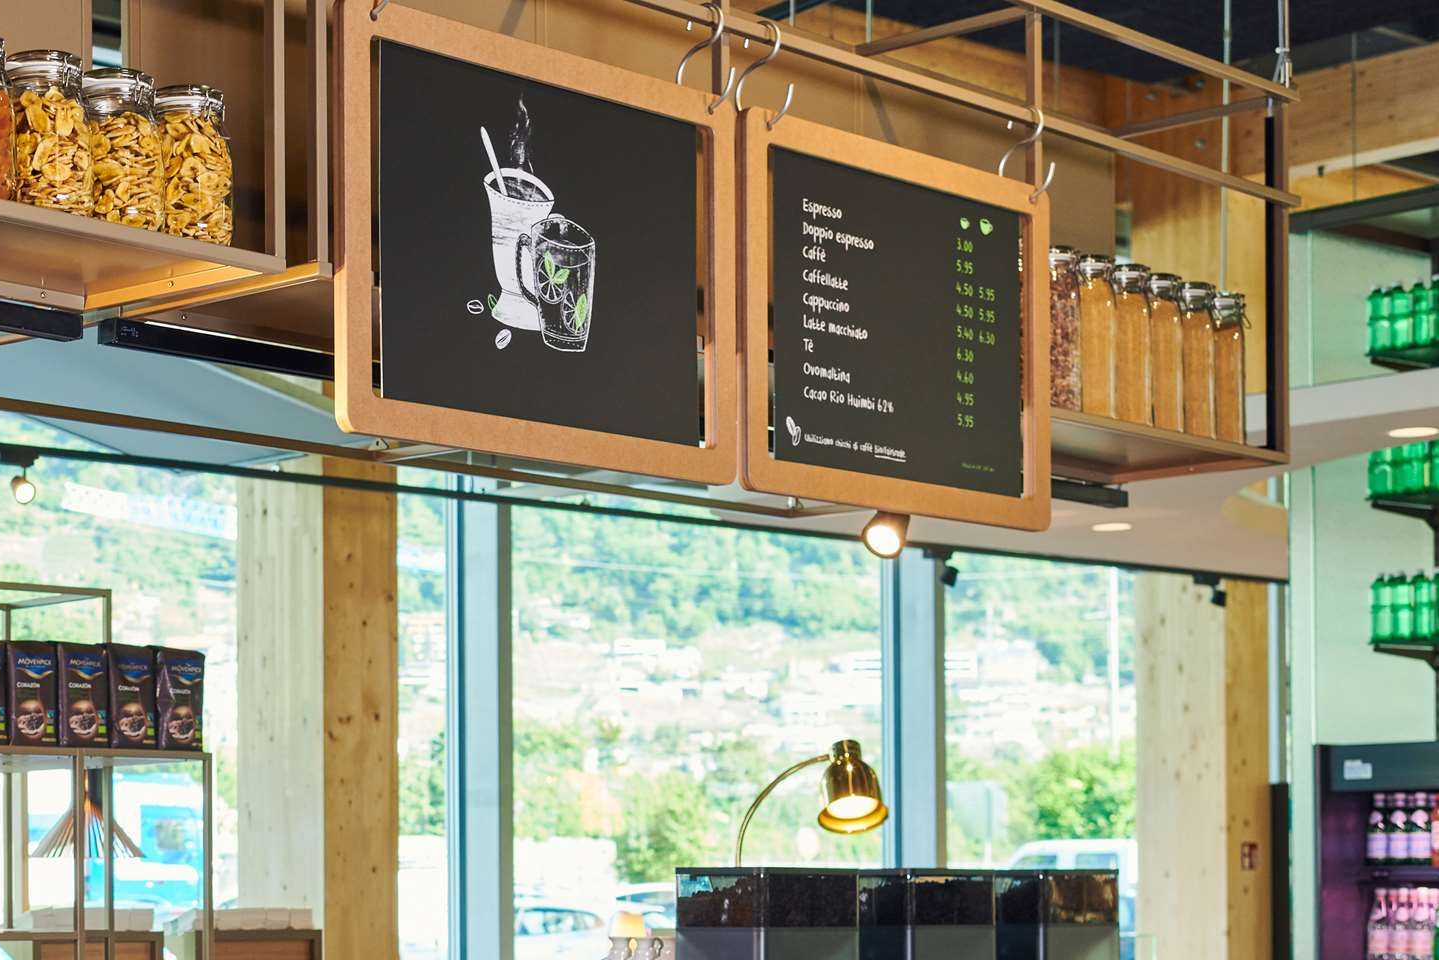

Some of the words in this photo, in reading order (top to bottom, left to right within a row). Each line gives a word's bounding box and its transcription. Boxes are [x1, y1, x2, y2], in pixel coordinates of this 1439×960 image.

[802, 198, 843, 219] Espresso
[802, 221, 834, 244] Doppio
[835, 232, 875, 251] espresso
[802, 246, 827, 262] Caffè
[802, 268, 849, 291] Caffellatte
[802, 292, 850, 313] Cappuccino
[803, 313, 826, 332] Latte
[828, 322, 869, 341] macchiato
[803, 362, 851, 384] Ovomaltina
[803, 386, 827, 402] Cacao
[829, 390, 845, 404] Rio
[846, 393, 875, 411] Huimbi
[877, 398, 895, 413] 62%
